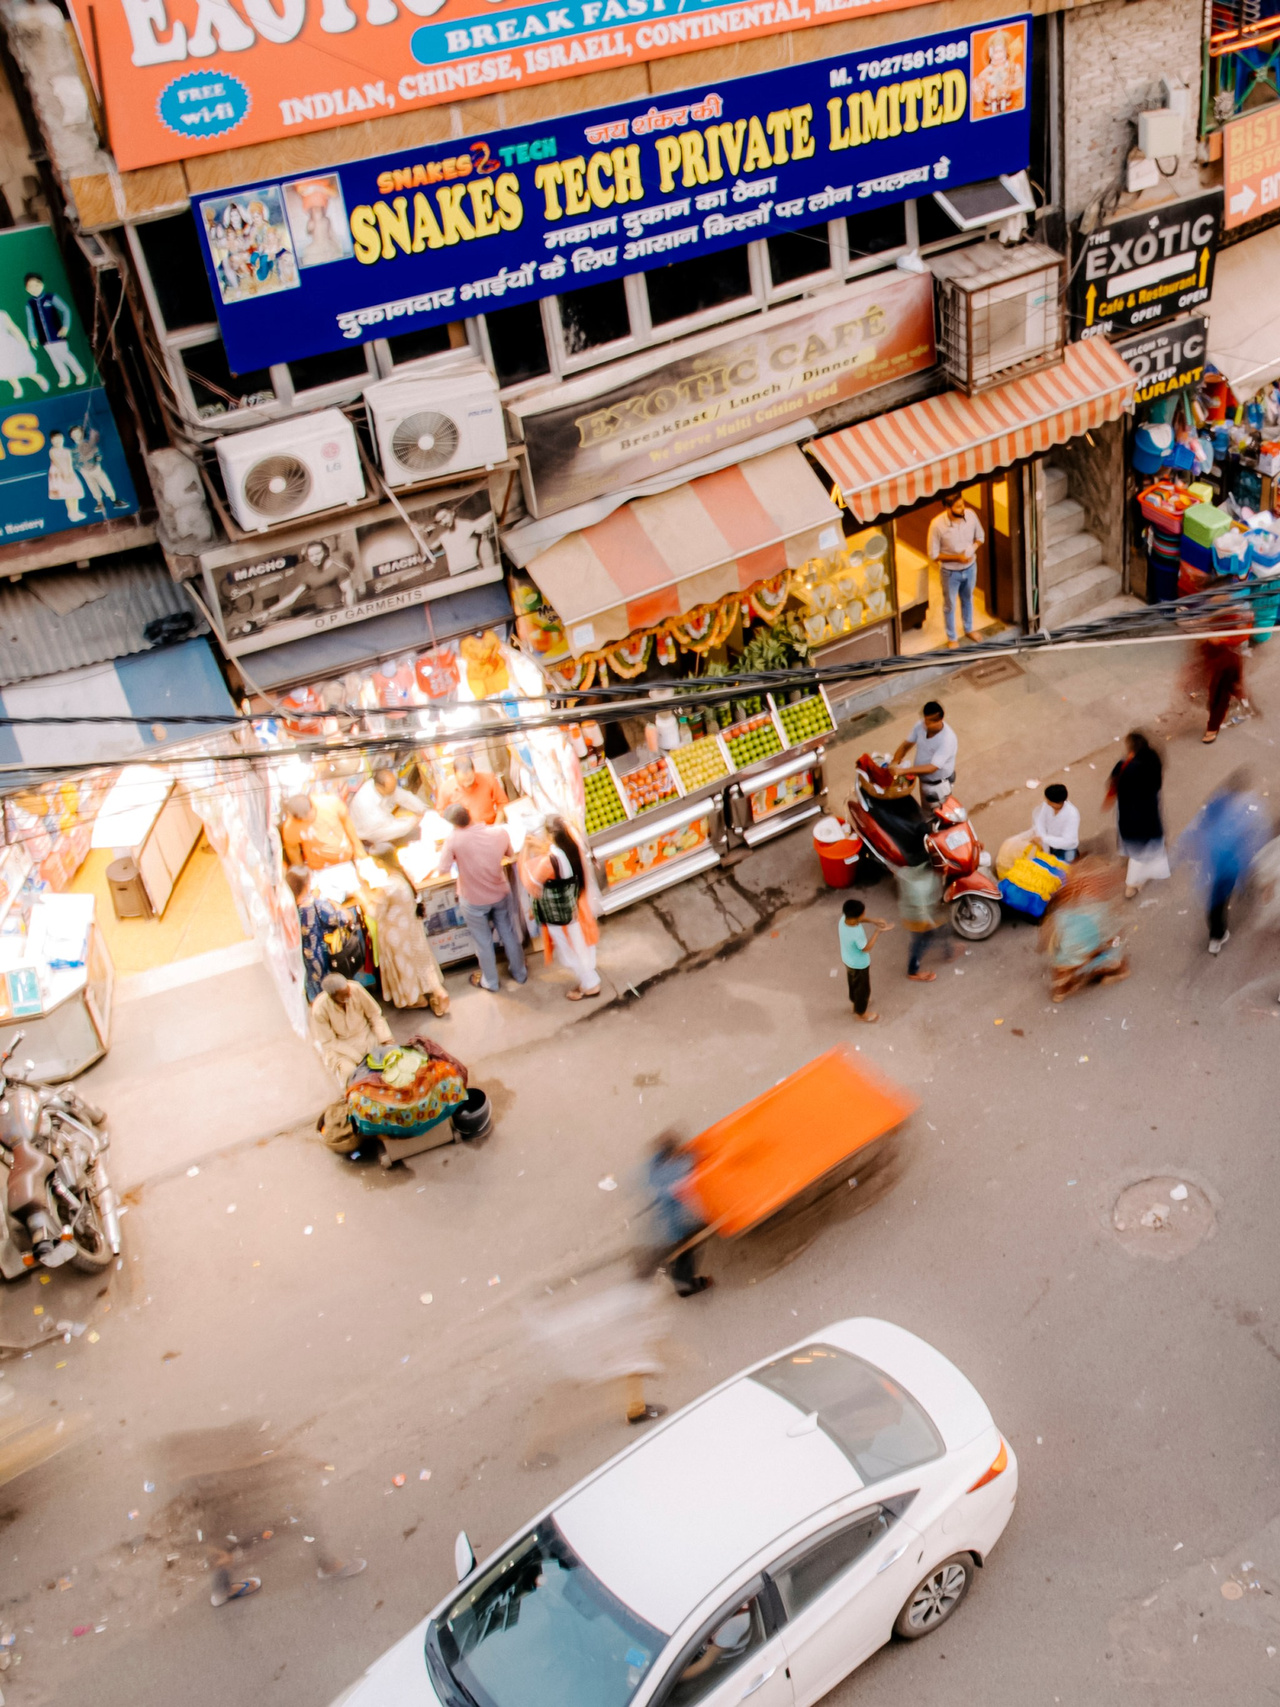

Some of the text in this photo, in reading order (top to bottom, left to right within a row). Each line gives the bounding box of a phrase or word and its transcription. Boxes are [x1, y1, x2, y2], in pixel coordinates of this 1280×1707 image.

[445, 15, 575, 53] BREAK
[279, 0, 812, 126] INDIAN, CHINESE, ISRAELI, CONTINENTAL,
[830, 41, 968, 88] M. 7027581388
[177, 83, 227, 104] FREE
[584, 93, 723, 144] जय शंकर की
[350, 68, 968, 265] SNAKES TECH PRIVATE LIMITED
[377, 136, 557, 194] SNAKES TECH
[543, 176, 778, 250] मकान दुकान का ठेका
[1089, 230, 1111, 246] THE
[336, 287, 456, 339] दुकानदार
[538, 254, 567, 281] के
[571, 246, 619, 275] लिए
[623, 225, 699, 261] आसान
[703, 199, 774, 240] किस्तों
[775, 196, 806, 219] पर
[808, 184, 853, 214] लोन
[857, 164, 931, 199] उपलब्ध
[1085, 214, 1215, 281] EXOTIC
[1081, 287, 1209, 341] OPEN OPEN OPEN
[1098, 273, 1197, 317] Café & Restaurant
[574, 358, 758, 449] EXOTIC
[768, 304, 889, 373] CAFÉ
[1130, 334, 1204, 378] OTIC
[619, 409, 709, 450] Breakfast
[729, 382, 782, 410] Lunch
[802, 353, 860, 384] Dinner
[715, 416, 752, 438] Multi
[755, 398, 804, 423] Cuisine
[807, 383, 838, 406] Food
[1133, 366, 1204, 404] AURANT
[234, 558, 286, 582] MACHO
[345, 589, 423, 620] GARMENTS
